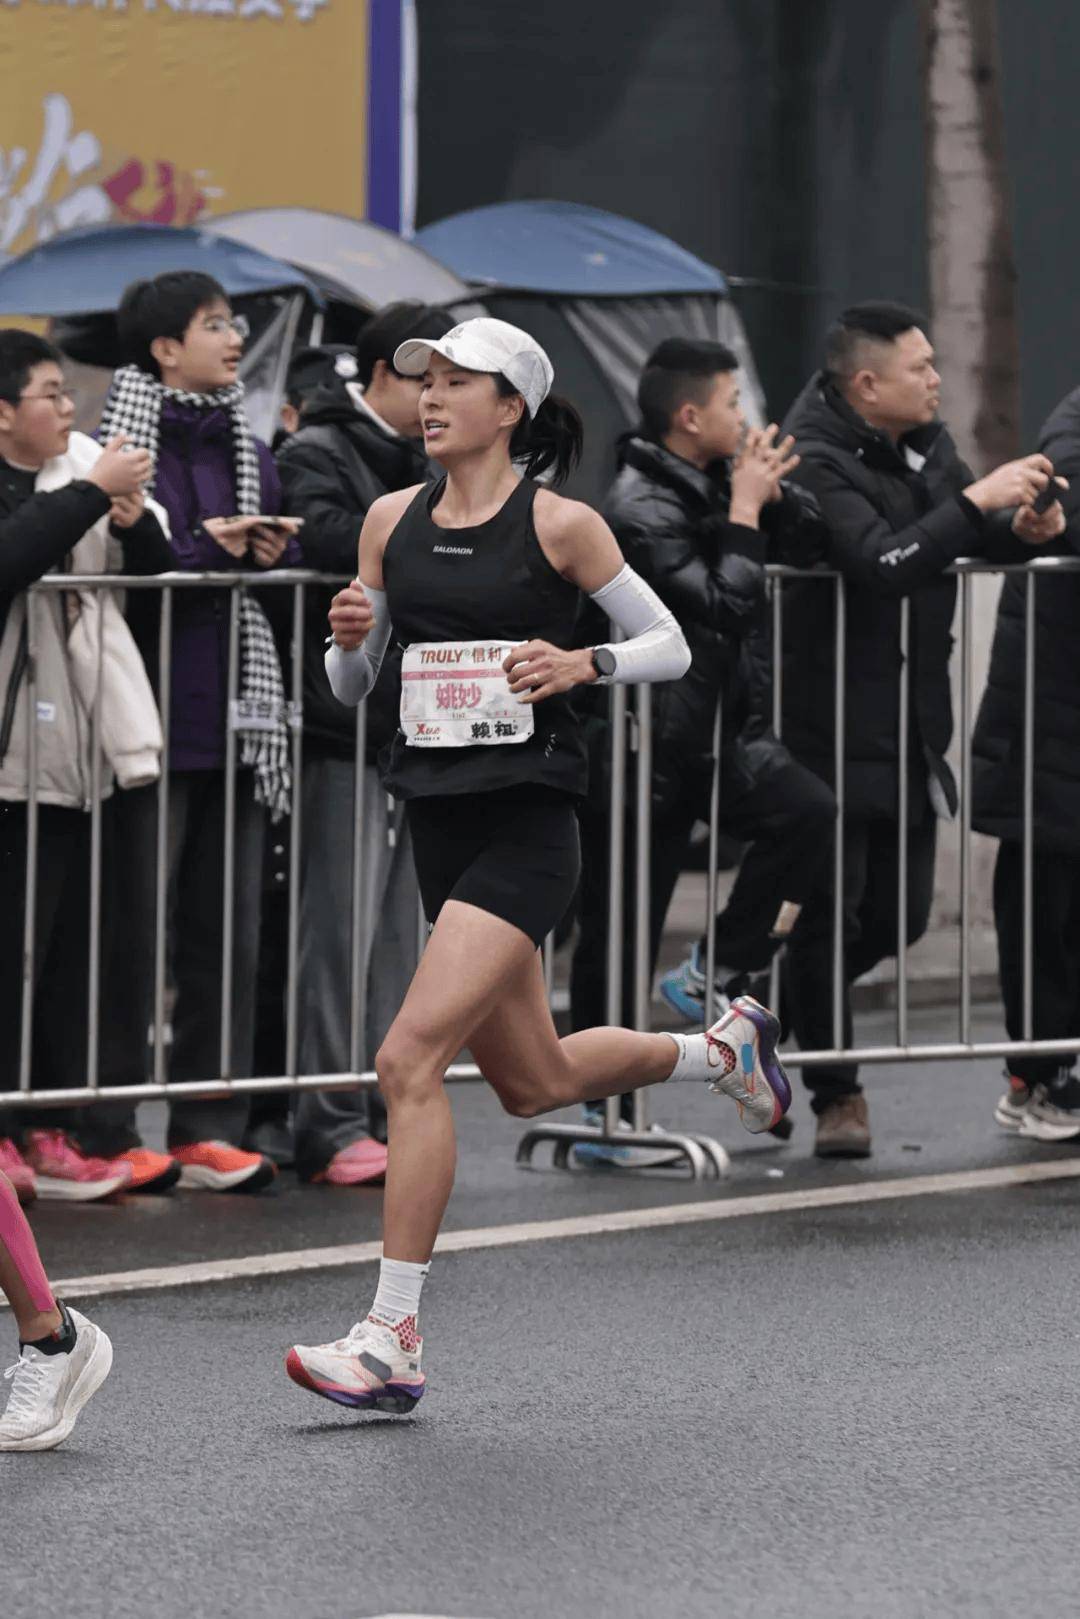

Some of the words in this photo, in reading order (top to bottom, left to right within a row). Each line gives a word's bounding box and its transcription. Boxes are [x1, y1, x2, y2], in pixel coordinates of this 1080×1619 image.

[432, 545, 473, 555] SALOMON
[420, 649, 463, 664] TRULY
[471, 647, 502, 664] 信利
